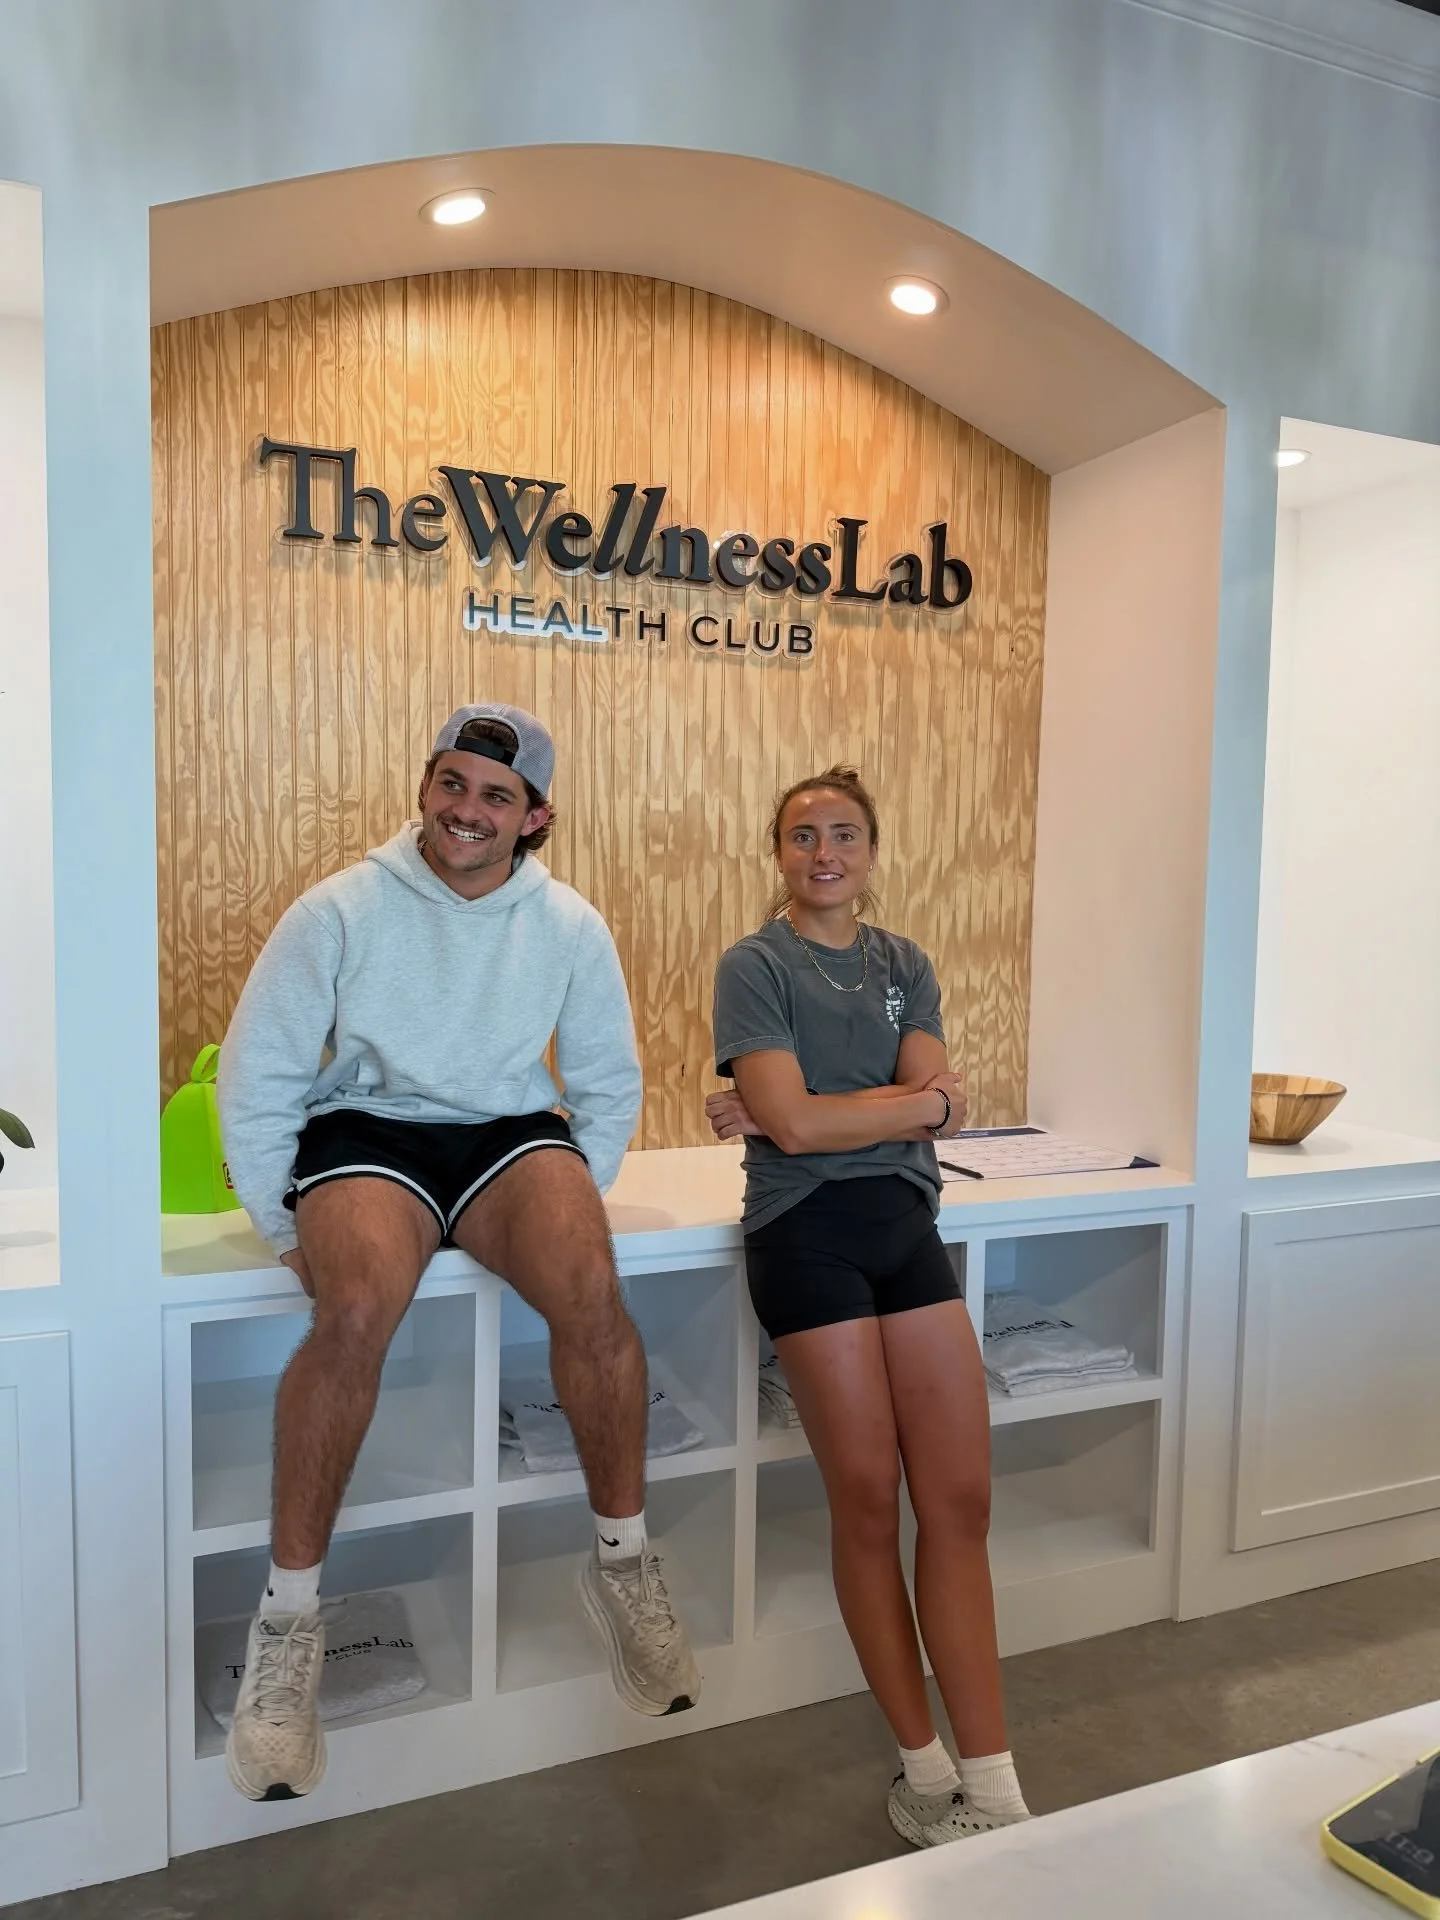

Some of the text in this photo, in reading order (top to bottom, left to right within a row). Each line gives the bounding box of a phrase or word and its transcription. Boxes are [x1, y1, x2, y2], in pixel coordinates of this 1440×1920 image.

[260, 436, 973, 608] TheWellnessLab
[468, 592, 814, 654] HEALTH CLUB
